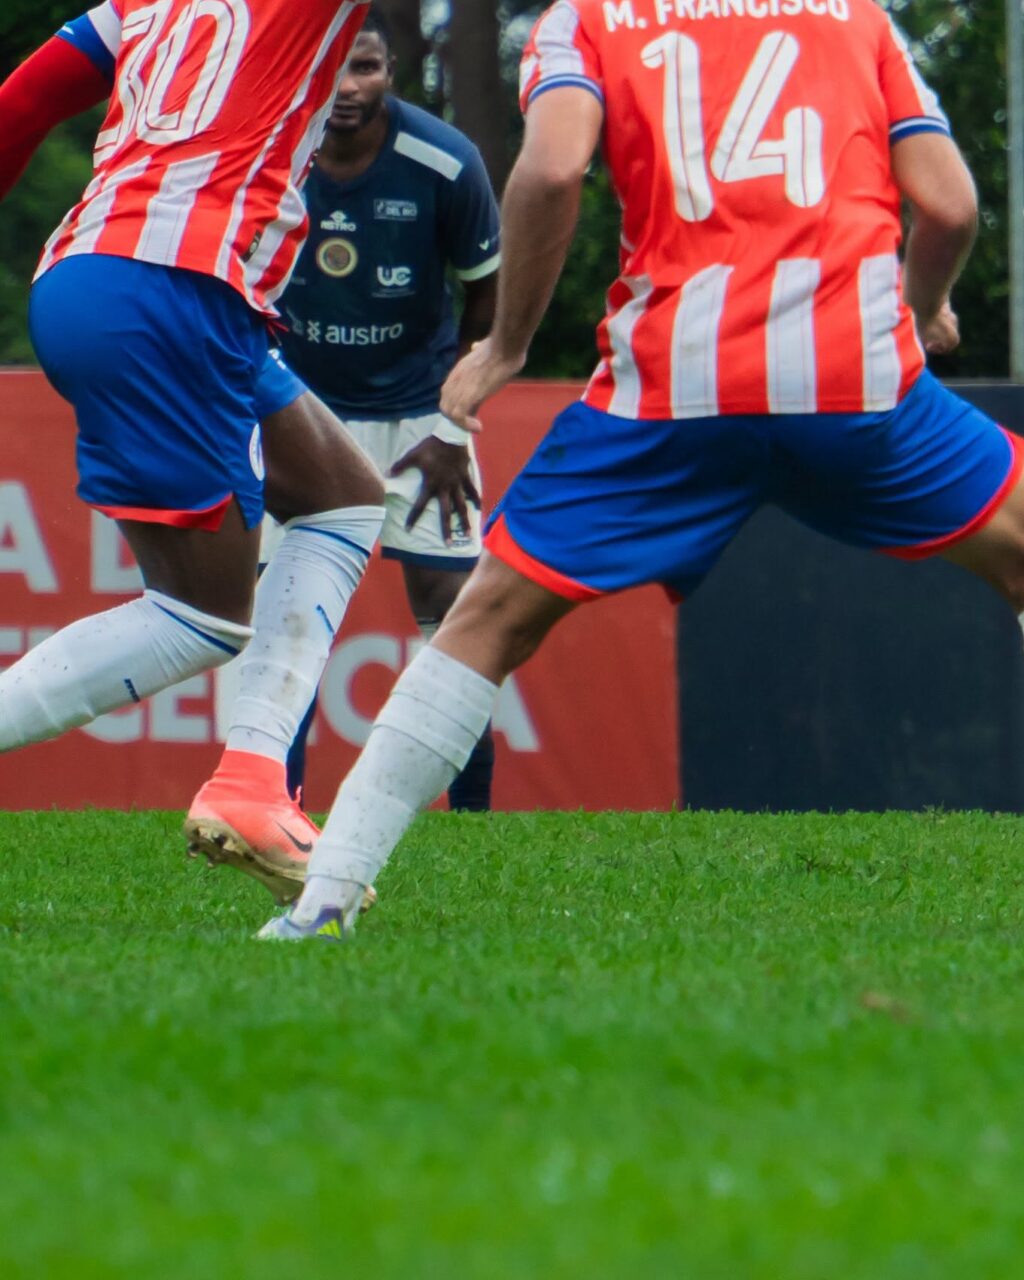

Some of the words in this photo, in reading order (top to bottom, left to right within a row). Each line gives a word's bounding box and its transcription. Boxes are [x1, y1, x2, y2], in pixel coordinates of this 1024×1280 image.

[603, 0, 648, 32] M.
[640, 30, 825, 223] 14
[325, 322, 403, 345] austro
